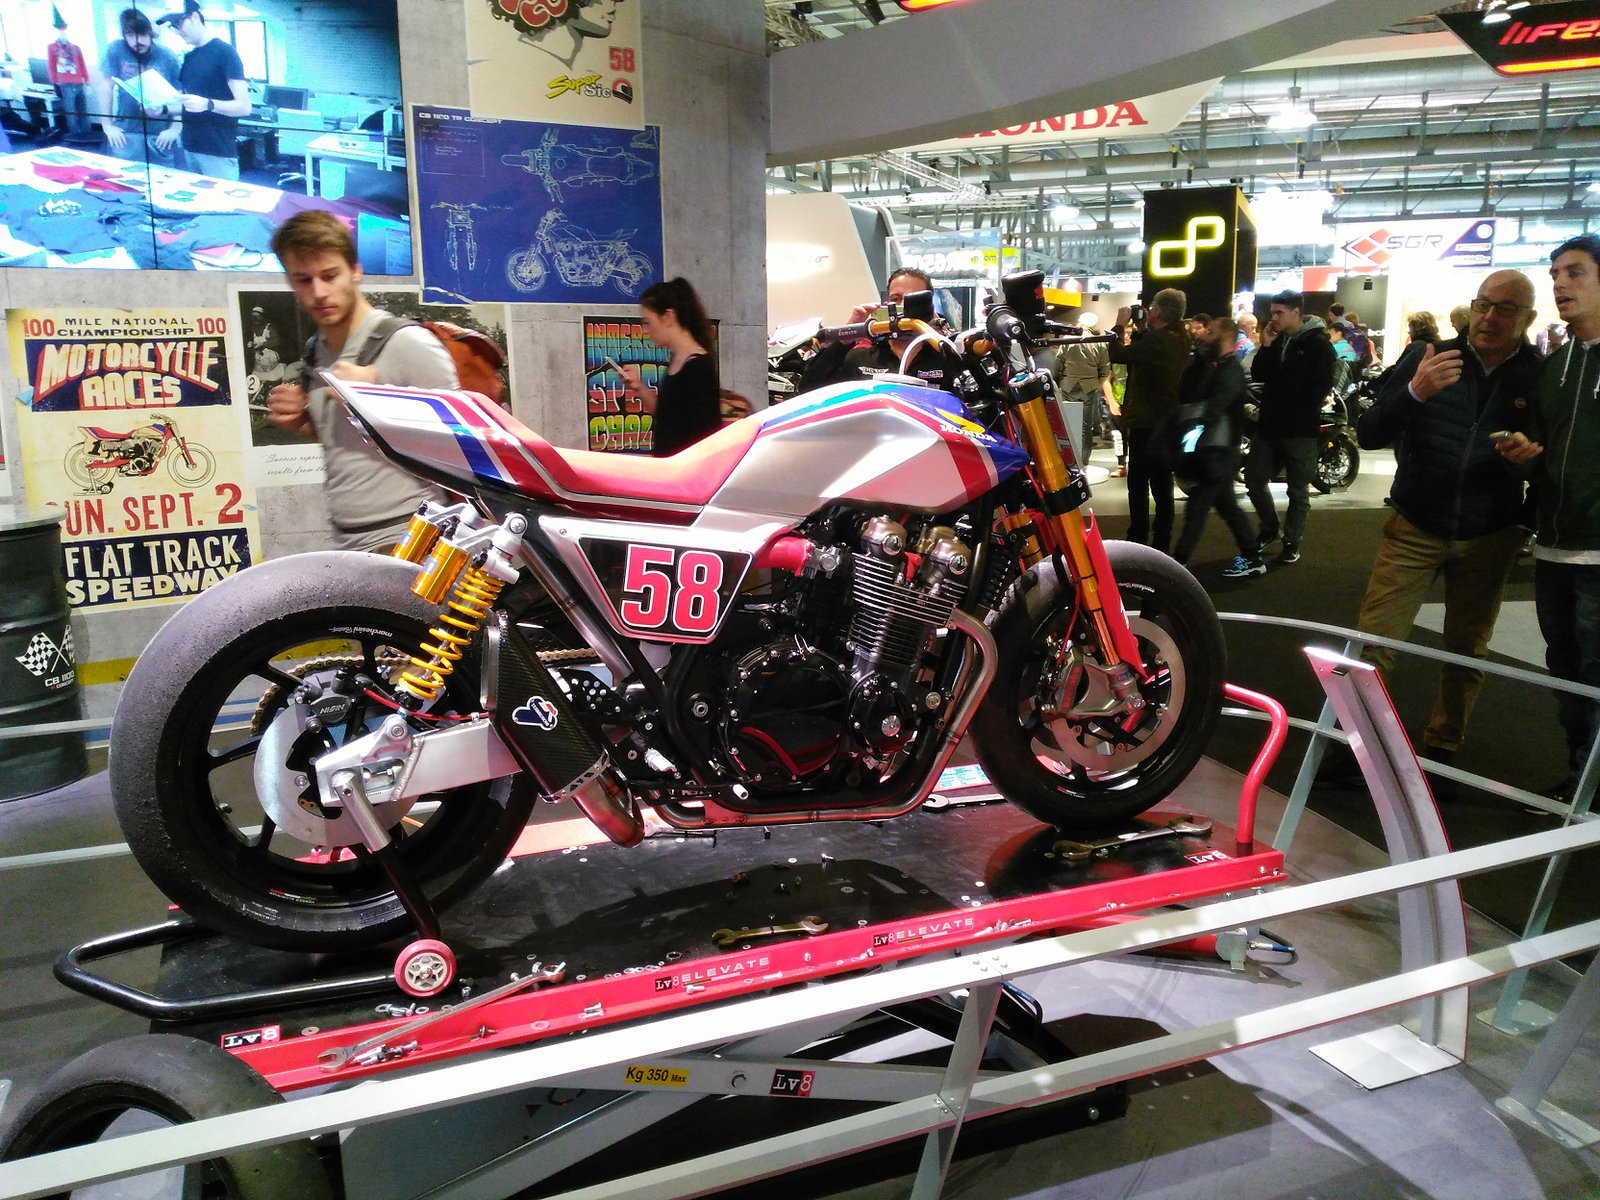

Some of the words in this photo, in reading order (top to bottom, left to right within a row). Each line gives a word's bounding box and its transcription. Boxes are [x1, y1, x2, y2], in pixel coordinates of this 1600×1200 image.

[608, 46, 635, 72] 58
[545, 74, 602, 99] Super
[584, 82, 611, 98] Sic
[958, 101, 1148, 139] ONDA
[1386, 234, 1443, 250] SGR
[22, 318, 55, 337] 100
[64, 318, 101, 326] MILE
[112, 317, 188, 326] NATIONAL
[196, 317, 227, 335] 100
[57, 327, 194, 337] CHAMPIONSHIP
[33, 340, 219, 404] MOTORCYCLE
[248, 377, 256, 391] 2
[79, 370, 182, 409] RACES
[44, 499, 114, 536] UN.
[122, 492, 204, 531] SEPT.
[214, 482, 244, 524] 2
[64, 543, 134, 578] FLAT
[143, 534, 242, 575] TRACK
[65, 564, 240, 605] SPEEDWAY
[620, 543, 724, 633] 58
[44, 676, 60, 687] CB
[873, 932, 895, 946] Lv8
[896, 917, 975, 940] ELEVATE
[656, 975, 680, 991] Lv8
[681, 957, 770, 982] ELEVATE
[223, 1028, 278, 1048] Lv8
[626, 1067, 644, 1083] Kg
[647, 1068, 669, 1082] 350
[671, 1075, 687, 1083] Max
[772, 1073, 814, 1092] Lv8
